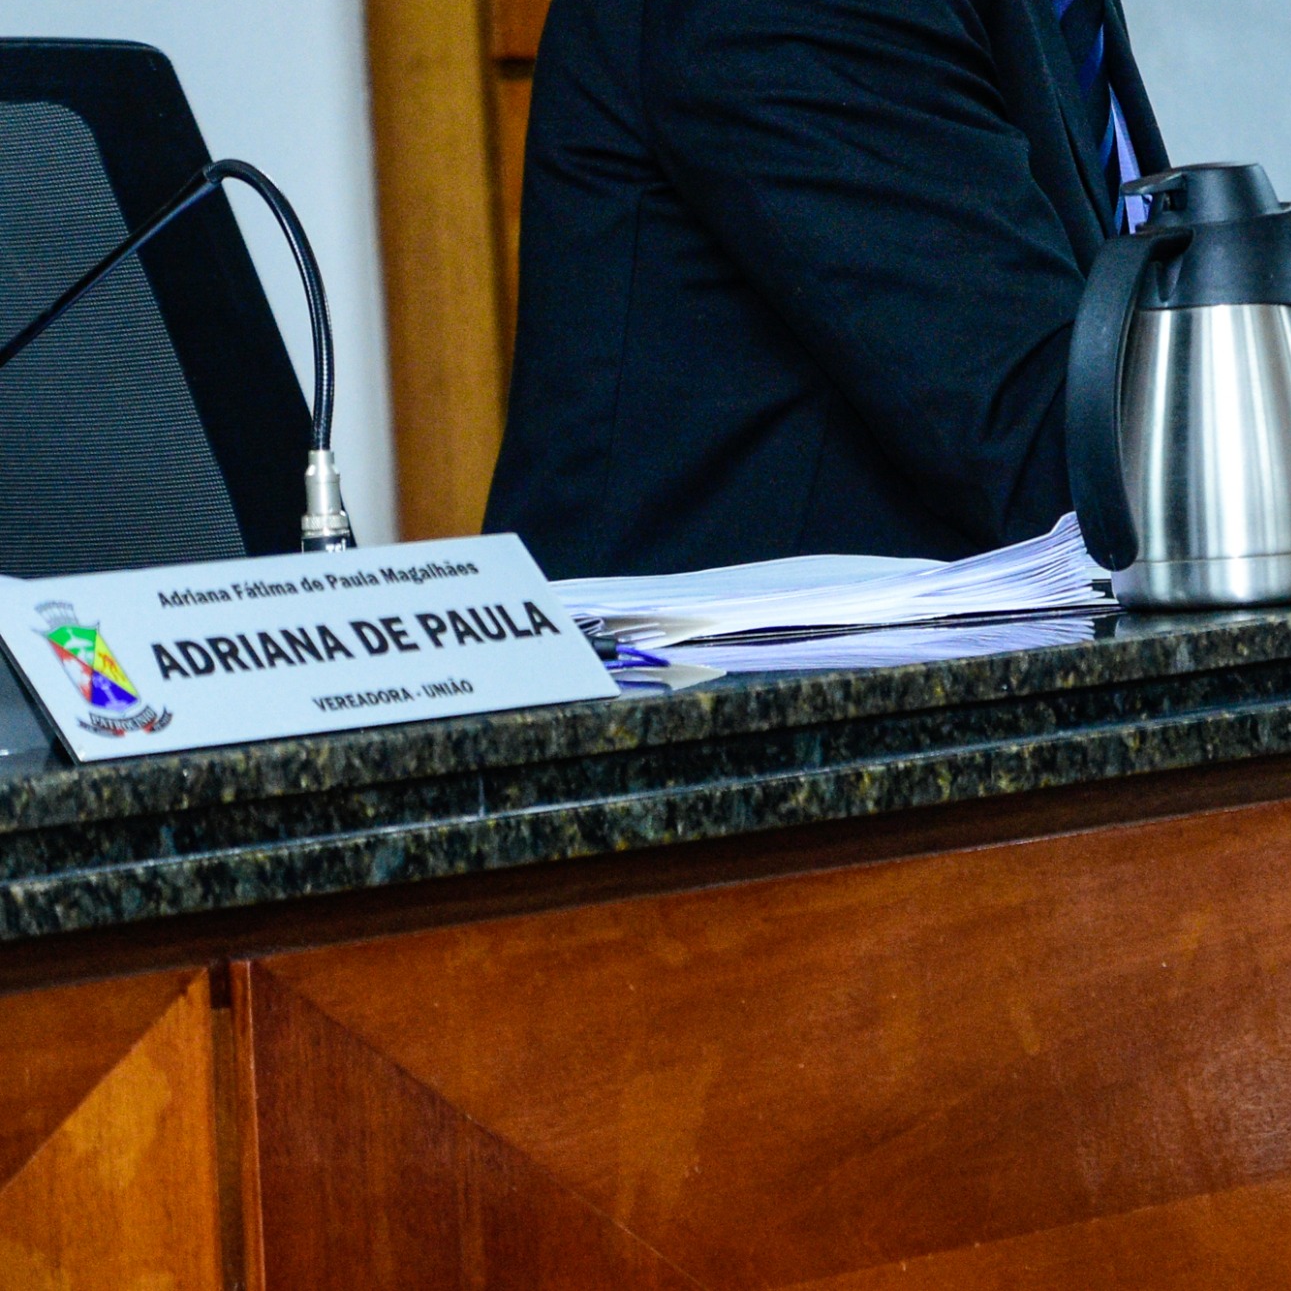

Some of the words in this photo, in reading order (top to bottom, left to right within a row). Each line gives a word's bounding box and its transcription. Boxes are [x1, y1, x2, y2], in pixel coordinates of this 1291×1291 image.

[157, 586, 233, 609] Adriana
[231, 578, 298, 600] Fátima
[300, 576, 325, 593] de
[325, 569, 380, 591] Paula
[380, 559, 480, 585] Magalhães
[151, 624, 355, 681] ADRIANA
[349, 615, 420, 656] DE
[415, 601, 561, 649] PAULA
[312, 687, 415, 712] VEREADORA
[422, 676, 474, 699] UNIÃO
